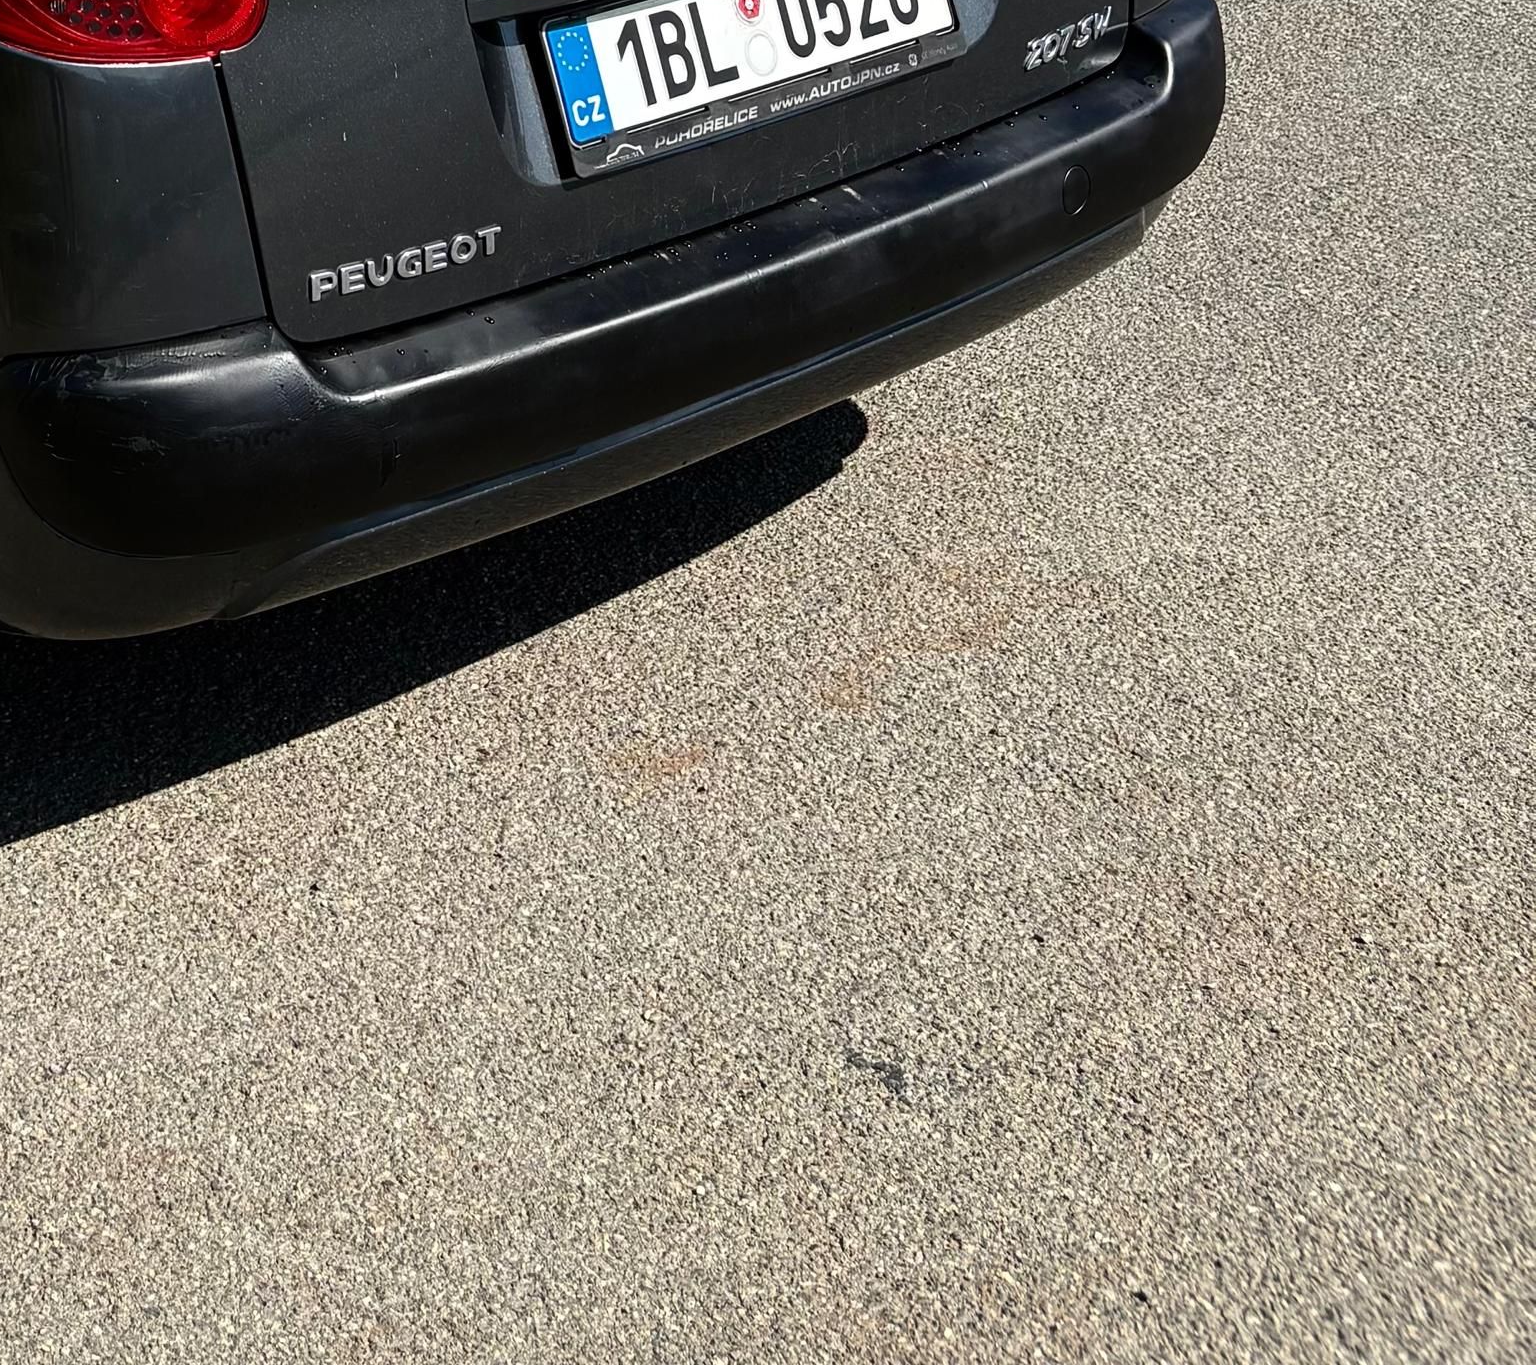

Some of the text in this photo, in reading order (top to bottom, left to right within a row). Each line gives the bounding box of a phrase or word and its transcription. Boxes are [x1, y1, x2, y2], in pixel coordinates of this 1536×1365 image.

[617, 2, 740, 107] 1BL
[571, 94, 606, 127] CZ
[308, 224, 502, 302] PEUGEOT
